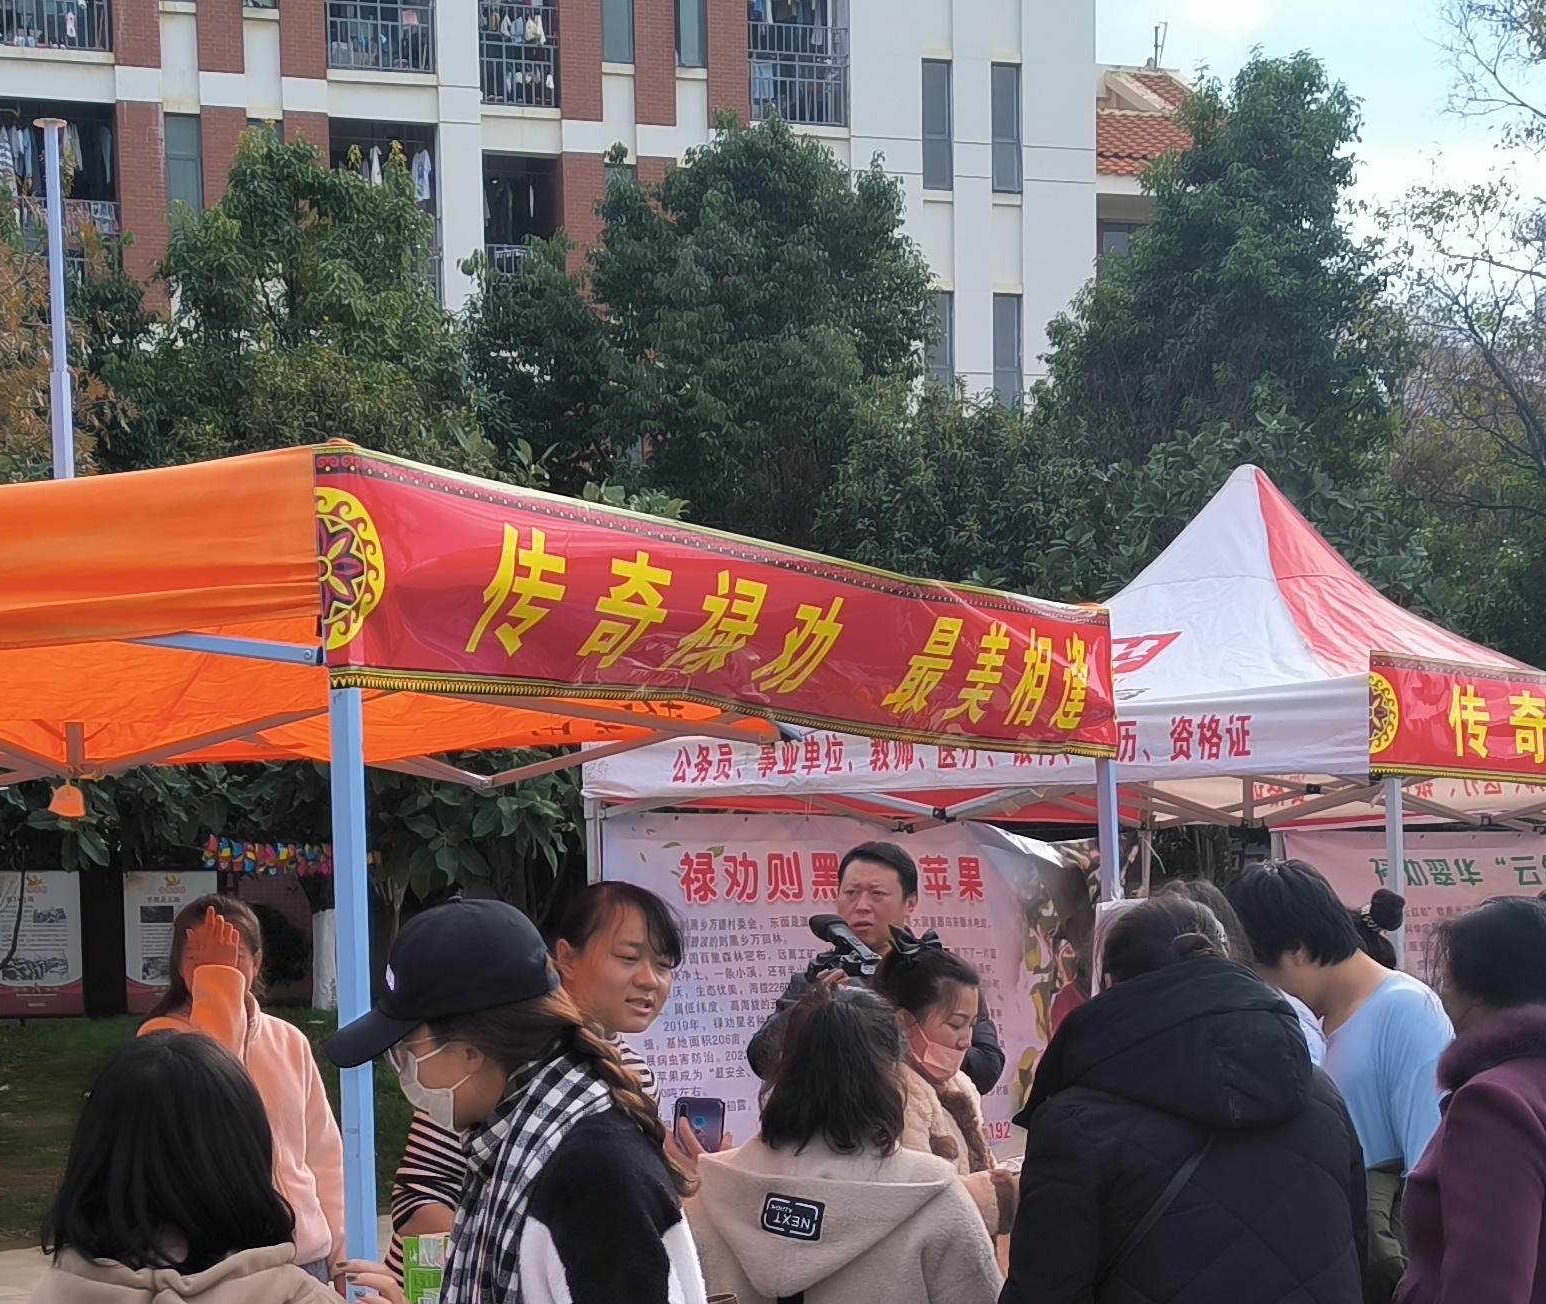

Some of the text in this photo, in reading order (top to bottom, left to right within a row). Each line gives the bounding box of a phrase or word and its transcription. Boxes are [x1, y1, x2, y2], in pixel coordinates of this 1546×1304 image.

[465, 522, 1091, 732] 传奇禄劝 最美相逢
[773, 1211, 811, 1230] NEXT
